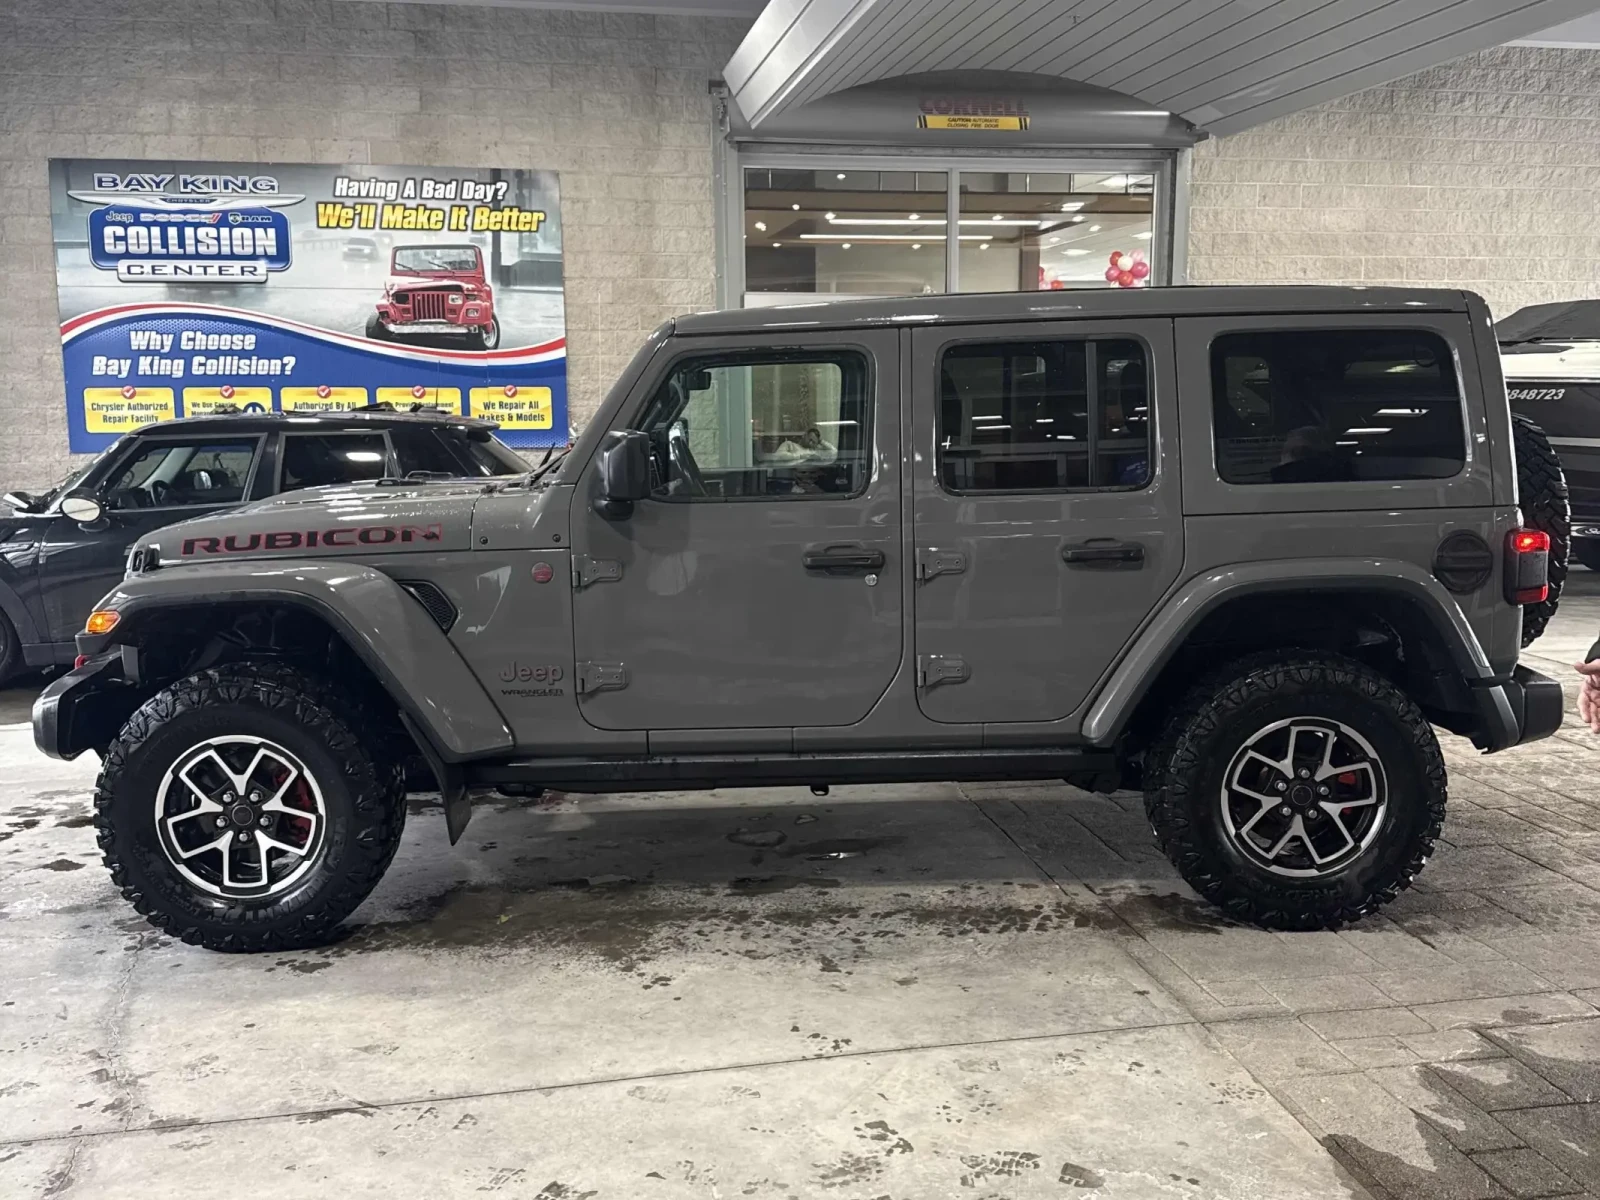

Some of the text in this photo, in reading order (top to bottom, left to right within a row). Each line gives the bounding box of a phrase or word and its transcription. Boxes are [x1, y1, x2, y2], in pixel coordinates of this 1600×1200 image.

[93, 173, 279, 194] BAY KING
[335, 178, 508, 202] Having A Bad Day?
[106, 211, 133, 223] Jeep
[140, 213, 214, 223] DODGE
[317, 203, 545, 232] We'll Make It Better
[103, 225, 277, 256] COLLISION
[126, 264, 259, 276] CENTER
[130, 330, 256, 353] Why Choose
[92, 356, 296, 378] Bay King Collision?
[91, 402, 168, 413] Chrysler Authorized
[294, 401, 357, 412] Authorized By All
[483, 400, 539, 412] We Repair All
[103, 414, 159, 424] Repair Facility
[478, 412, 545, 422] Makes & Models
[181, 523, 442, 557] RUBICON
[499, 660, 563, 685] Jeep
[501, 688, 564, 696] WRANGLER
